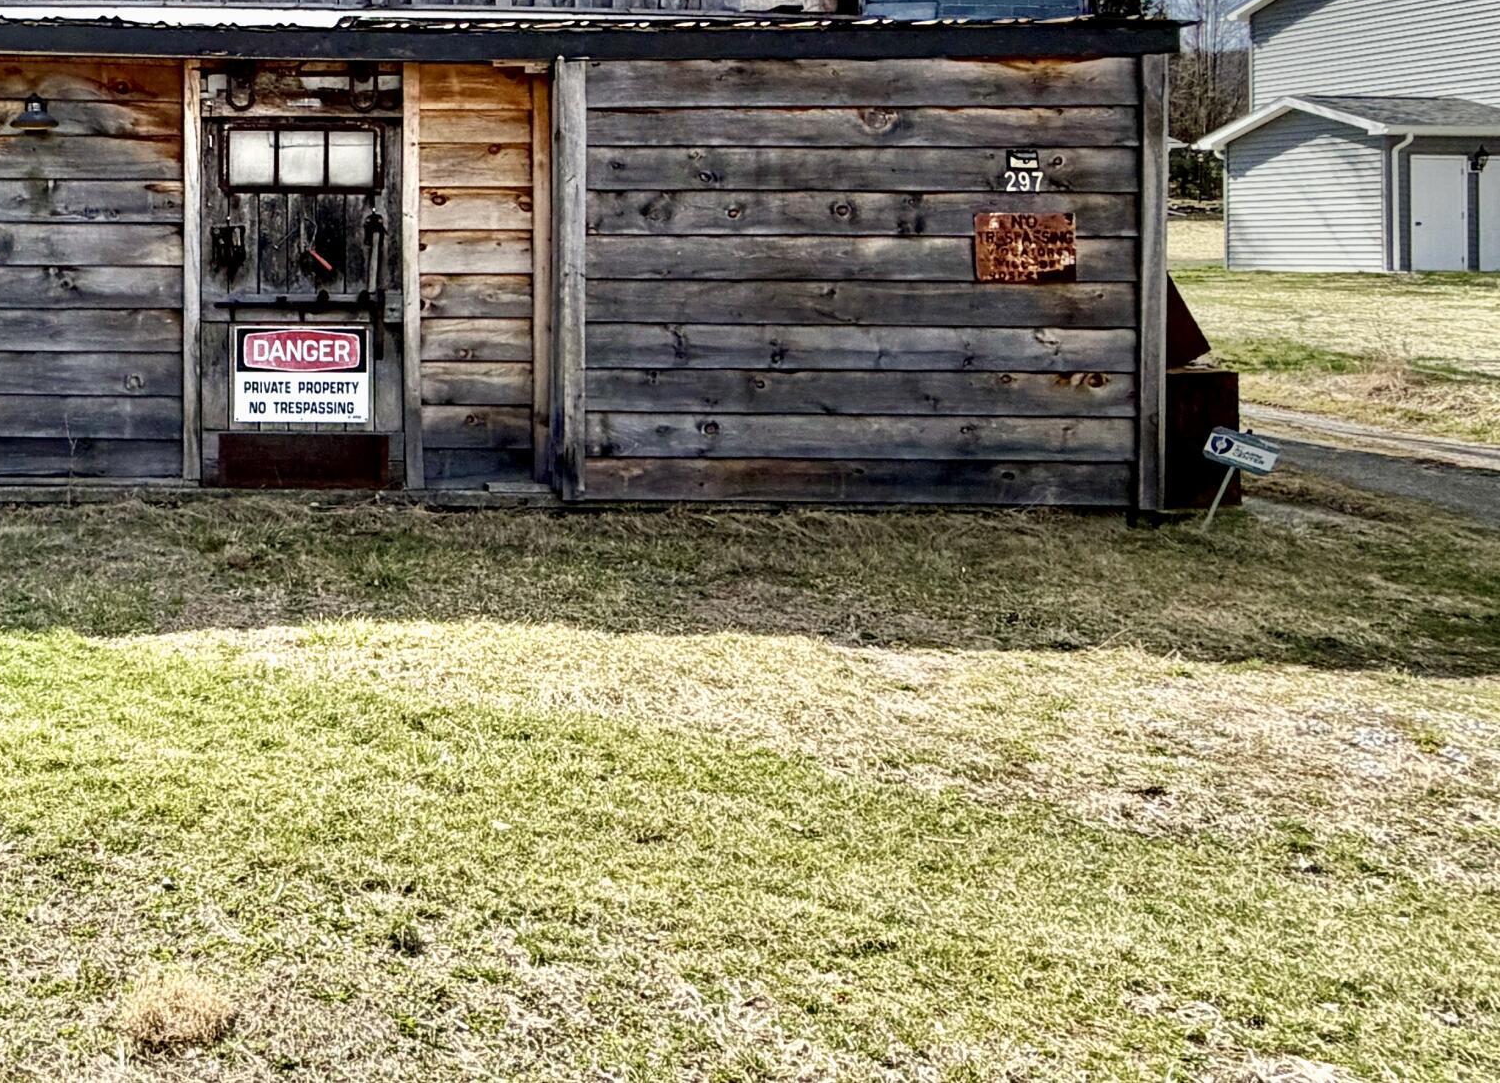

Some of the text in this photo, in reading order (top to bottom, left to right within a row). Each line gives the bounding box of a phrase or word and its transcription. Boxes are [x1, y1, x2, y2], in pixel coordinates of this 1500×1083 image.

[1004, 171, 1044, 192] 297
[1011, 214, 1038, 229] NO
[253, 339, 351, 362] DANGER
[243, 381, 359, 394] PRIVATE PROPERTY
[249, 402, 355, 415] NO TRESPASSING
